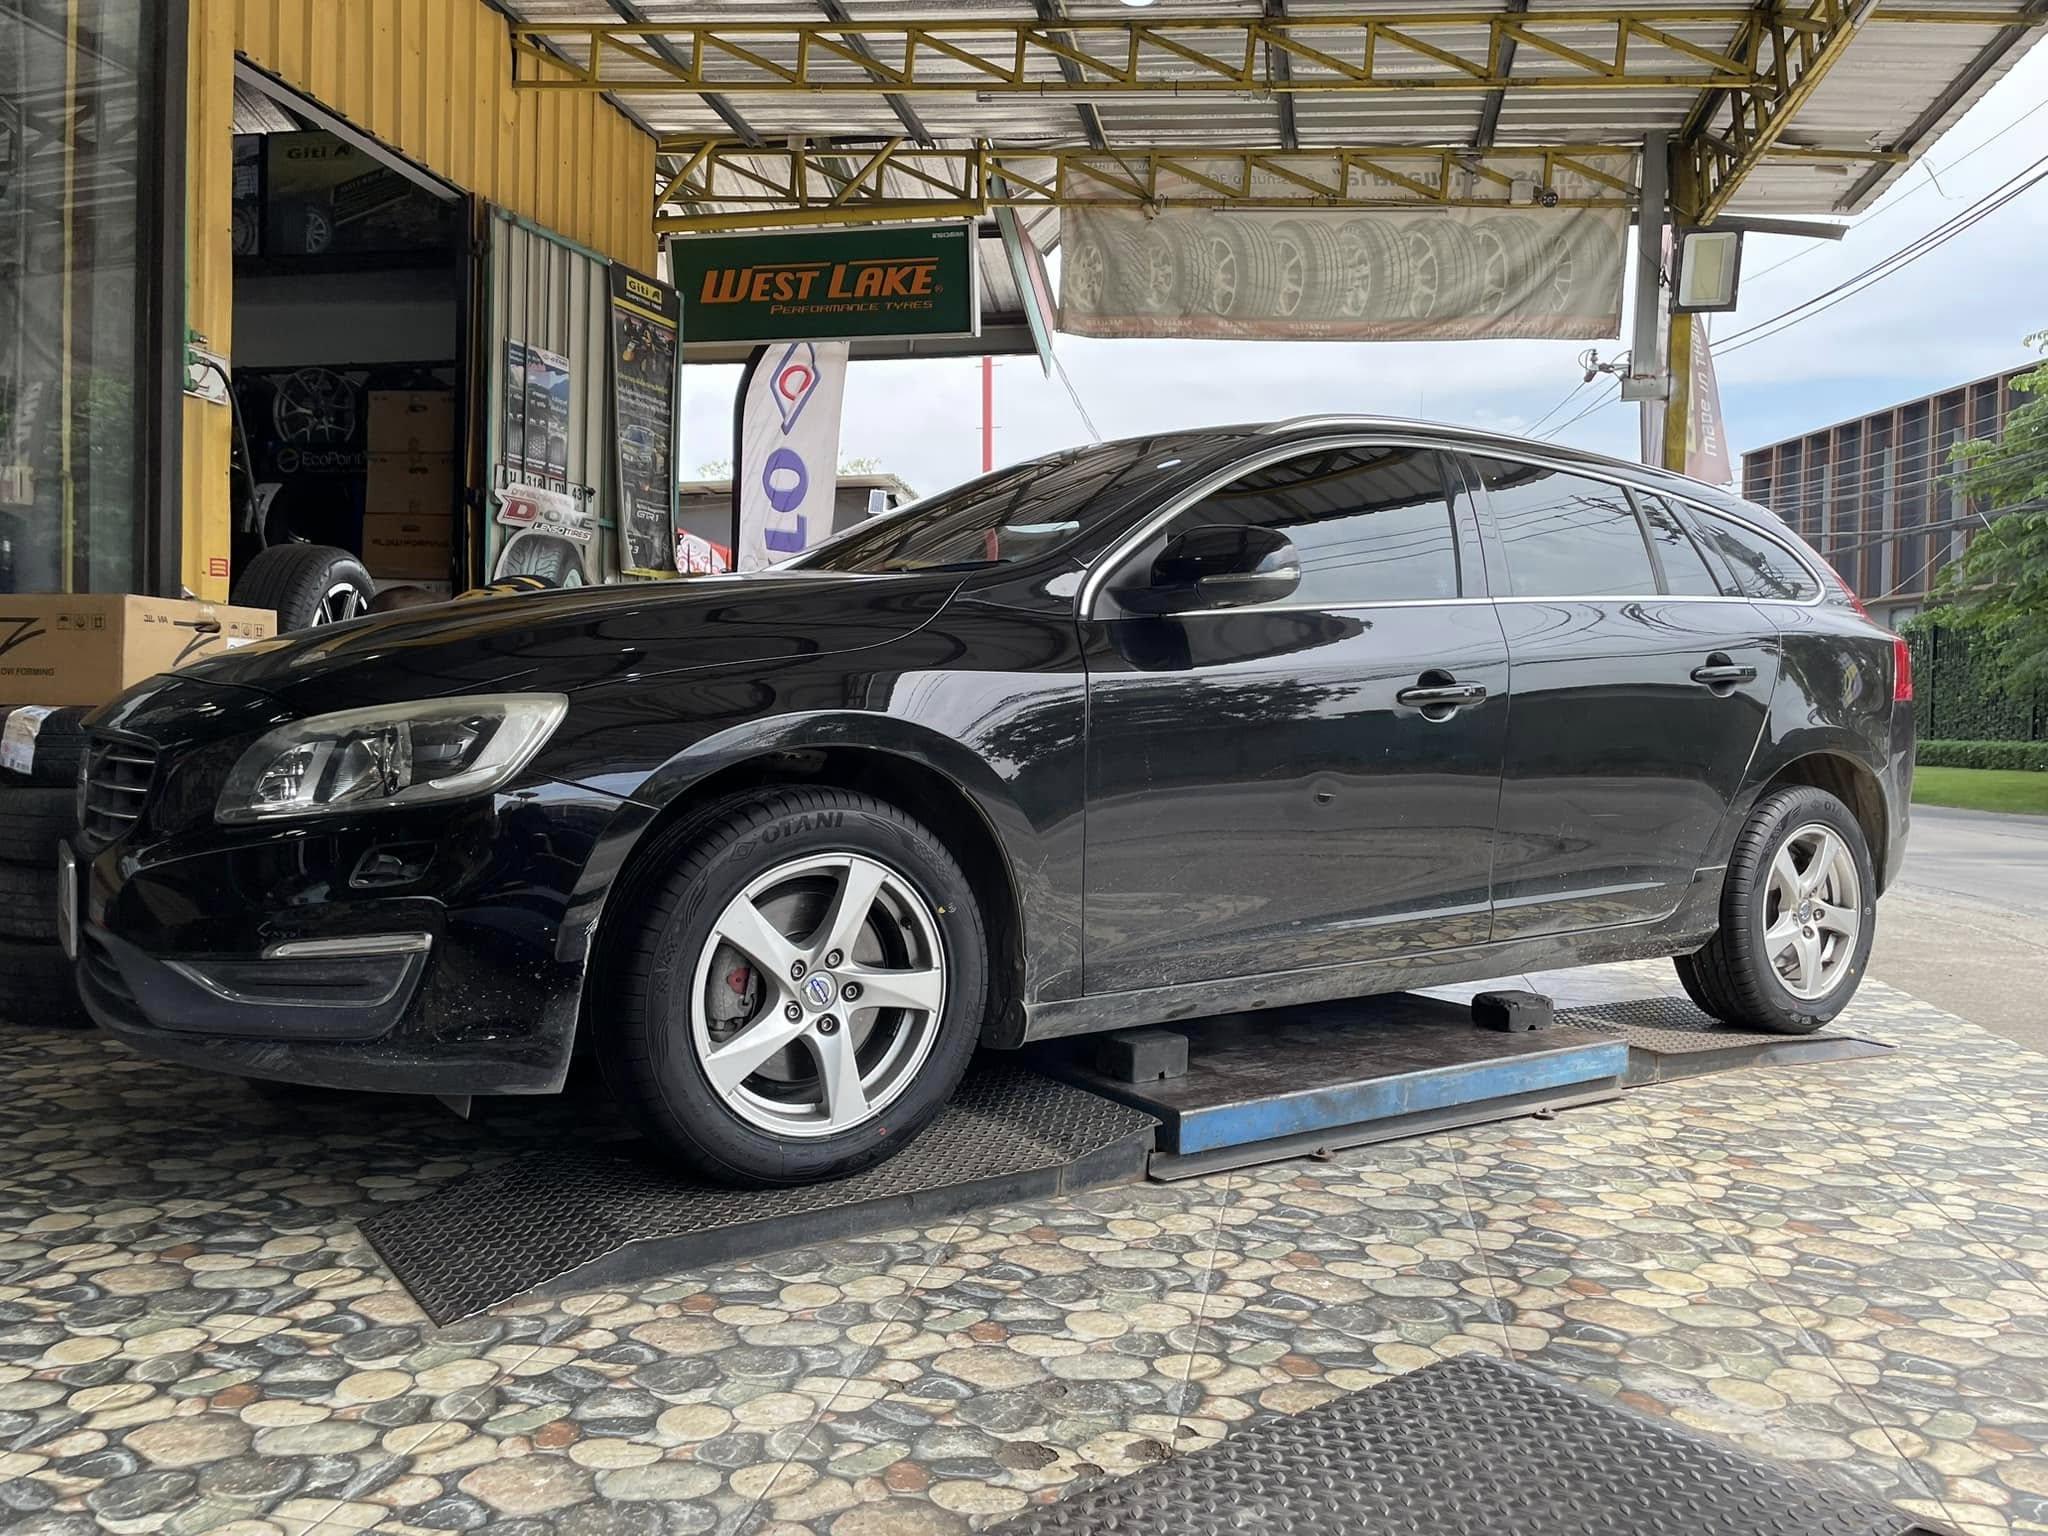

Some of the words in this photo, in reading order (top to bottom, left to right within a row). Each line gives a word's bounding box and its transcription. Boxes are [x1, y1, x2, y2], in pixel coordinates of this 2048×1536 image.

[628, 279, 649, 296] Giti
[701, 266, 820, 304] WEST
[828, 262, 937, 299] LAKE
[770, 301, 880, 314] PERFORMANCE
[885, 300, 934, 310] TYRES
[533, 522, 564, 534] LENSO
[565, 527, 592, 540] TIRES
[761, 811, 844, 843] OTANI
